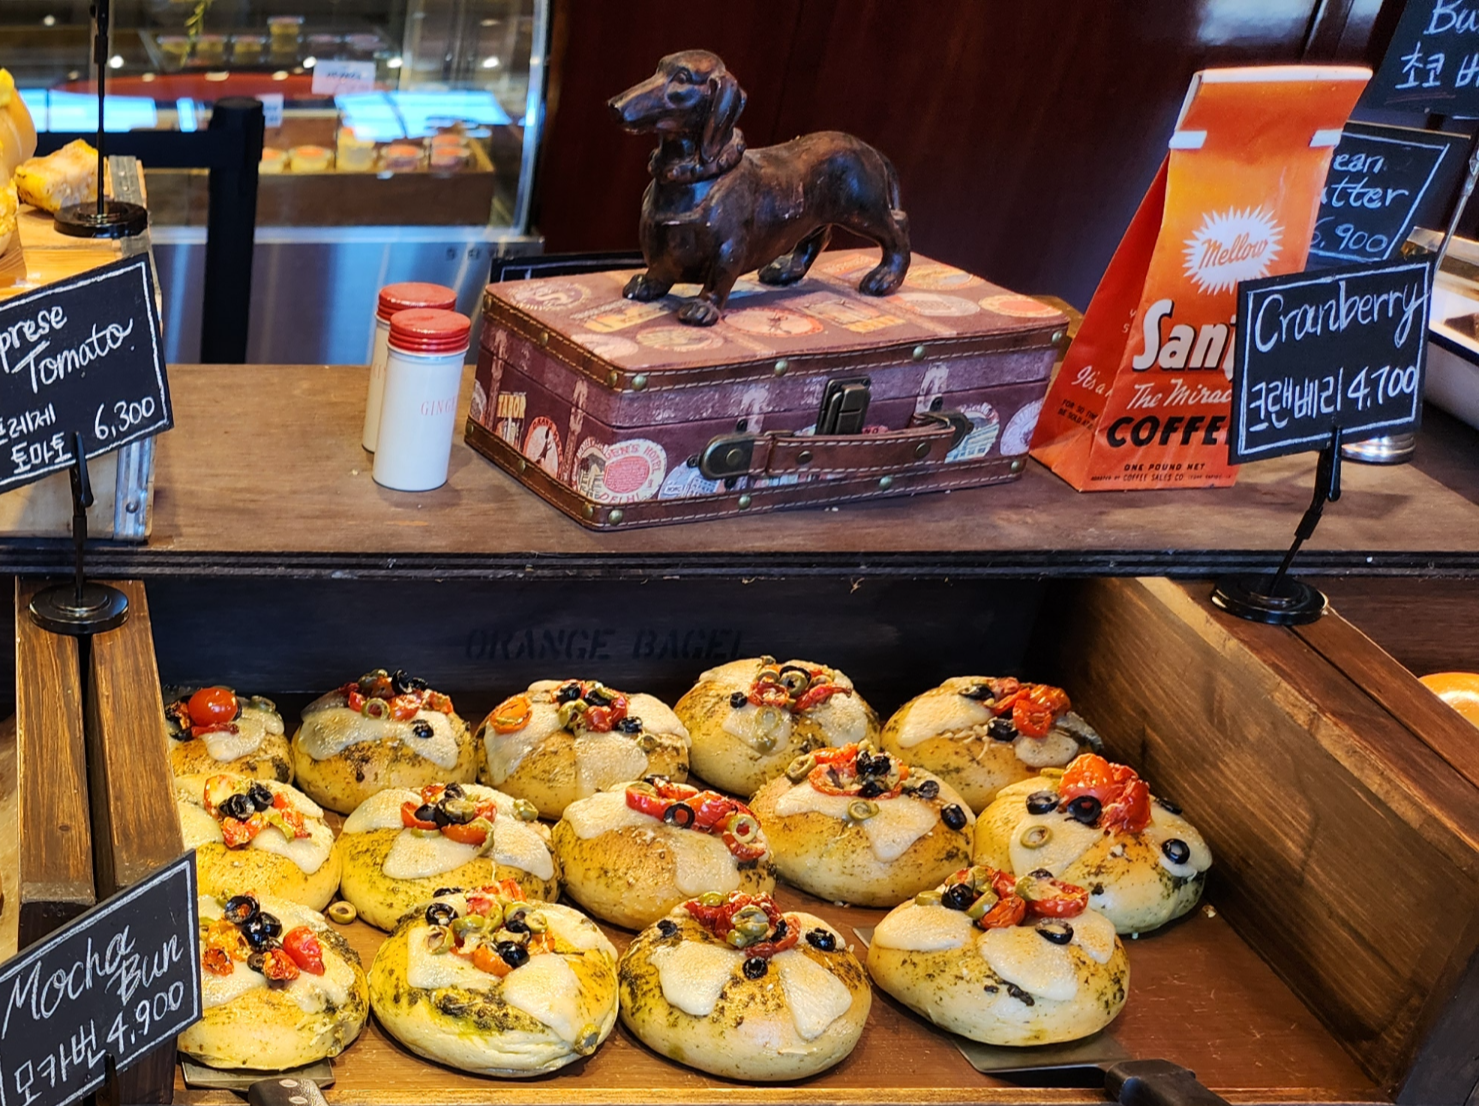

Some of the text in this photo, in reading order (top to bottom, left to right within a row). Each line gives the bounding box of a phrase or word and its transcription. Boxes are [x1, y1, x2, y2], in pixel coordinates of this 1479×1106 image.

[1394, 41, 1445, 89] 초코
[1332, 153, 1385, 173] ean
[1320, 176, 1409, 209] tter
[1198, 232, 1269, 271] Mellow
[1254, 280, 1429, 353] Cranberry
[11, 318, 134, 394] Tomato
[1126, 378, 1232, 410] The Mirac
[1249, 366, 1344, 432] 크랜베리
[94, 396, 155, 440] 6,300
[1106, 415, 1230, 448] COFFE
[10, 432, 73, 474] 토마토
[1124, 463, 1206, 471] ONE POUND NET
[1123, 474, 1148, 482] COFFEE
[1151, 474, 1172, 482] SALES
[464, 627, 617, 661] ORANGE
[1, 925, 136, 1040] Mocha
[105, 934, 184, 1006] Bun
